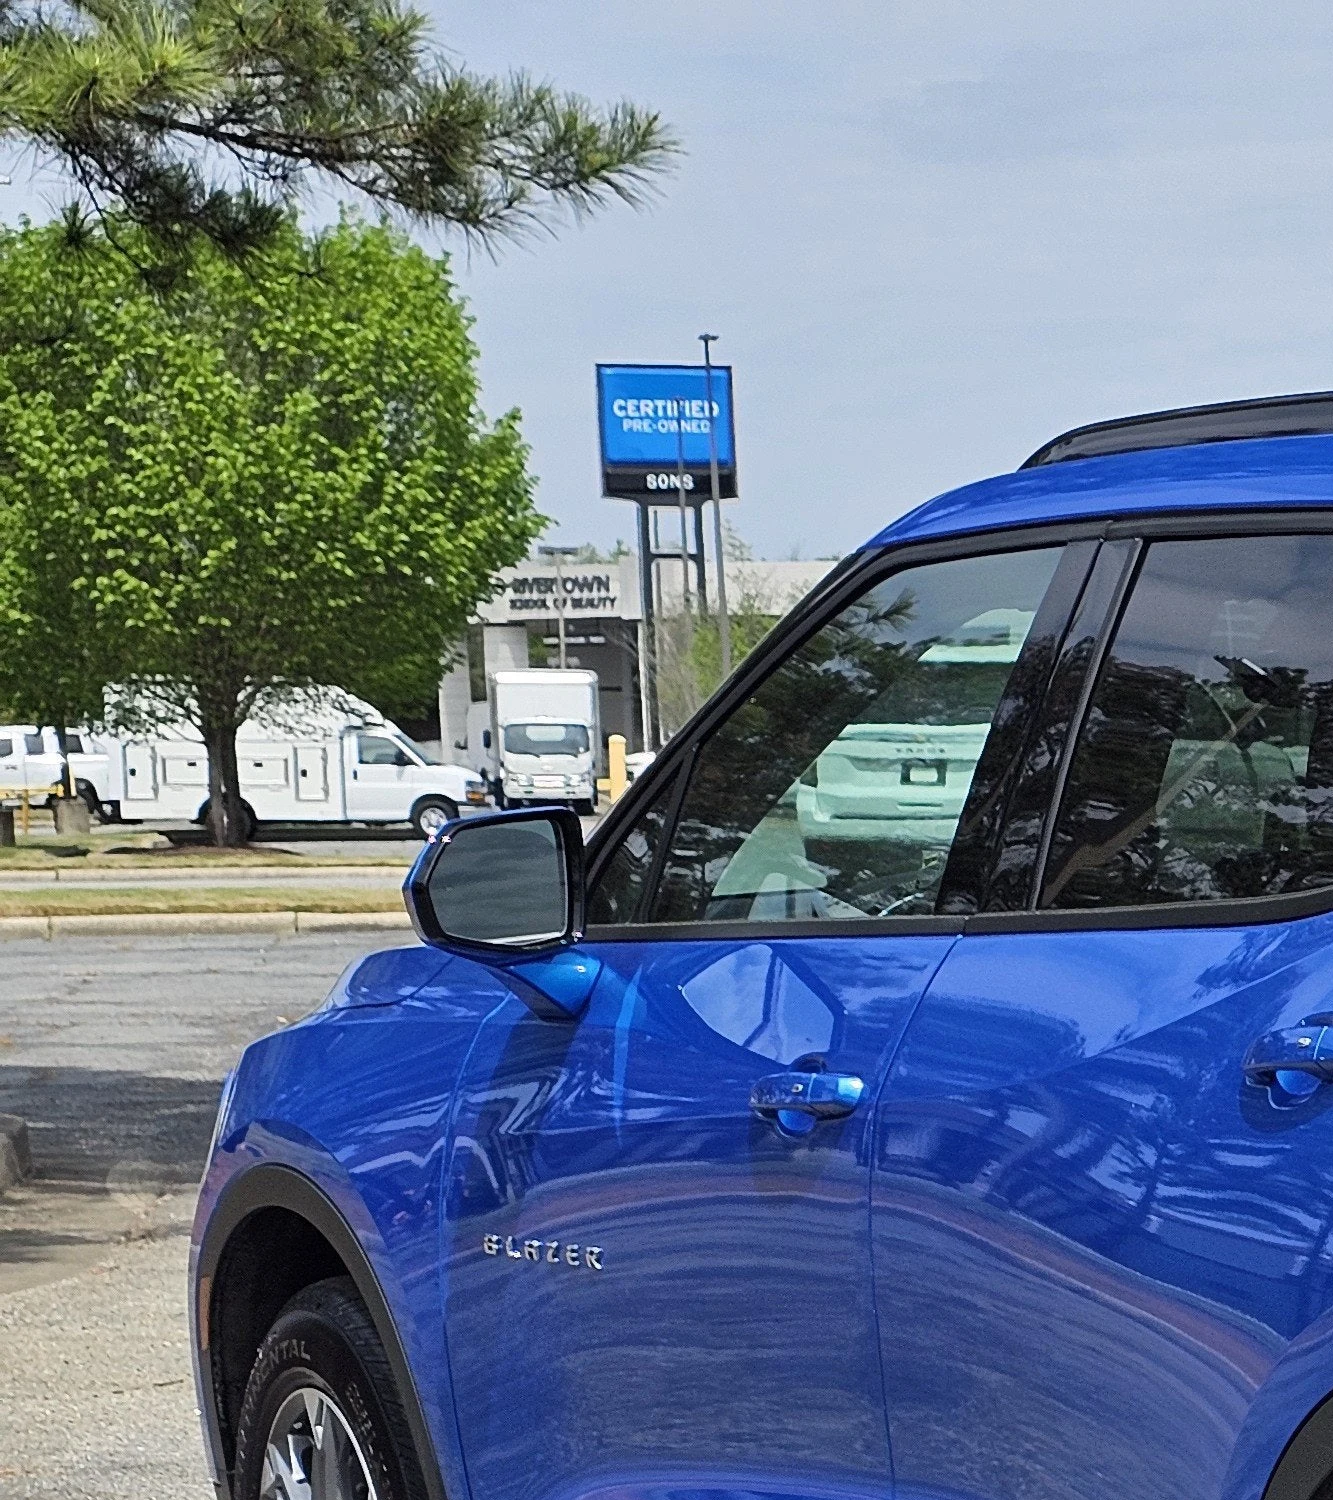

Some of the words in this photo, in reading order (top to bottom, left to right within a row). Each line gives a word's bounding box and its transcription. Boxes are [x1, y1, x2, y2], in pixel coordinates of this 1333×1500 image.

[622, 418, 710, 433] PRE-OWNED
[646, 473, 695, 490] SONS
[511, 574, 610, 594] RIVEROWN
[484, 1233, 604, 1270] BLAZER
